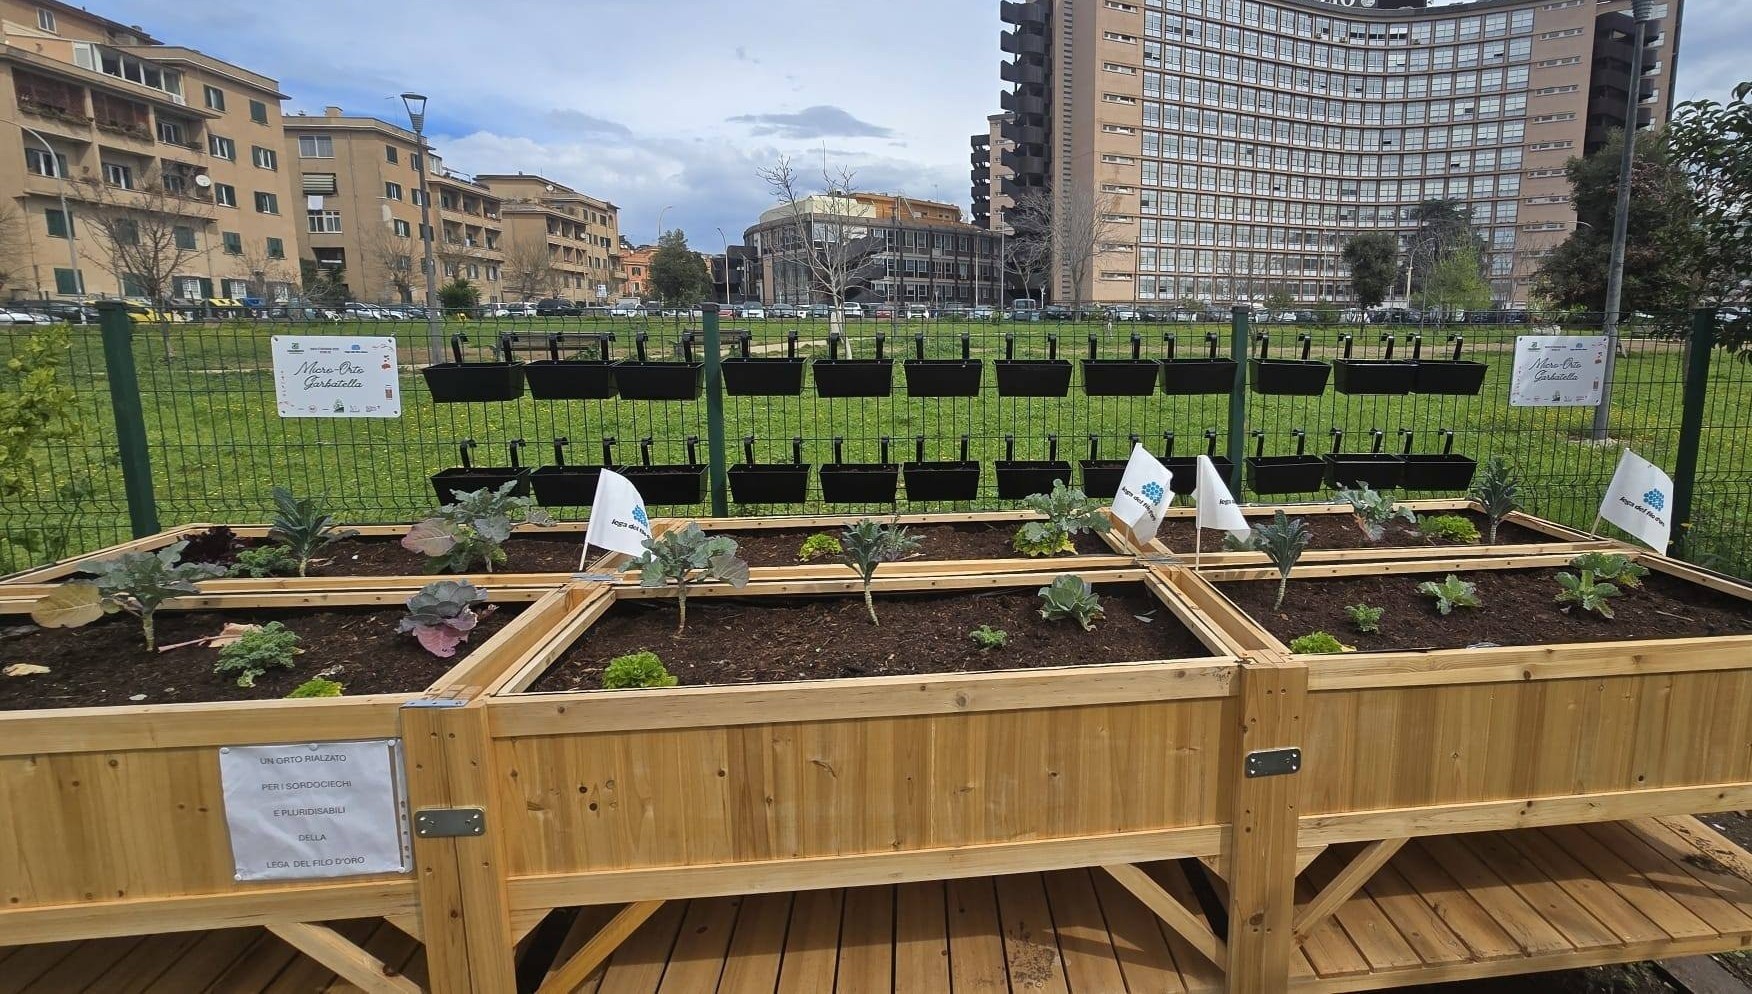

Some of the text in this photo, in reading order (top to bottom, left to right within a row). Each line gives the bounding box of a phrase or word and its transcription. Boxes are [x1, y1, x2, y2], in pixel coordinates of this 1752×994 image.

[293, 361, 365, 375] Micro-Orto
[1528, 357, 1582, 370] Micro-Orto
[303, 375, 363, 390] Garbatella
[1533, 370, 1579, 383] Garbatella
[1619, 496, 1635, 508] lega
[1635, 504, 1648, 513] del
[611, 518, 627, 528] lega
[628, 523, 639, 532] del
[259, 754, 347, 765] UN ORTO RIALZATO
[261, 783, 279, 791] PER
[285, 780, 352, 790] SORDOCIECHI
[273, 807, 346, 817] E PLURIDISABILI
[298, 834, 326, 842] DELLA
[266, 856, 365, 869] LEGA DEL FILO D'ORO
